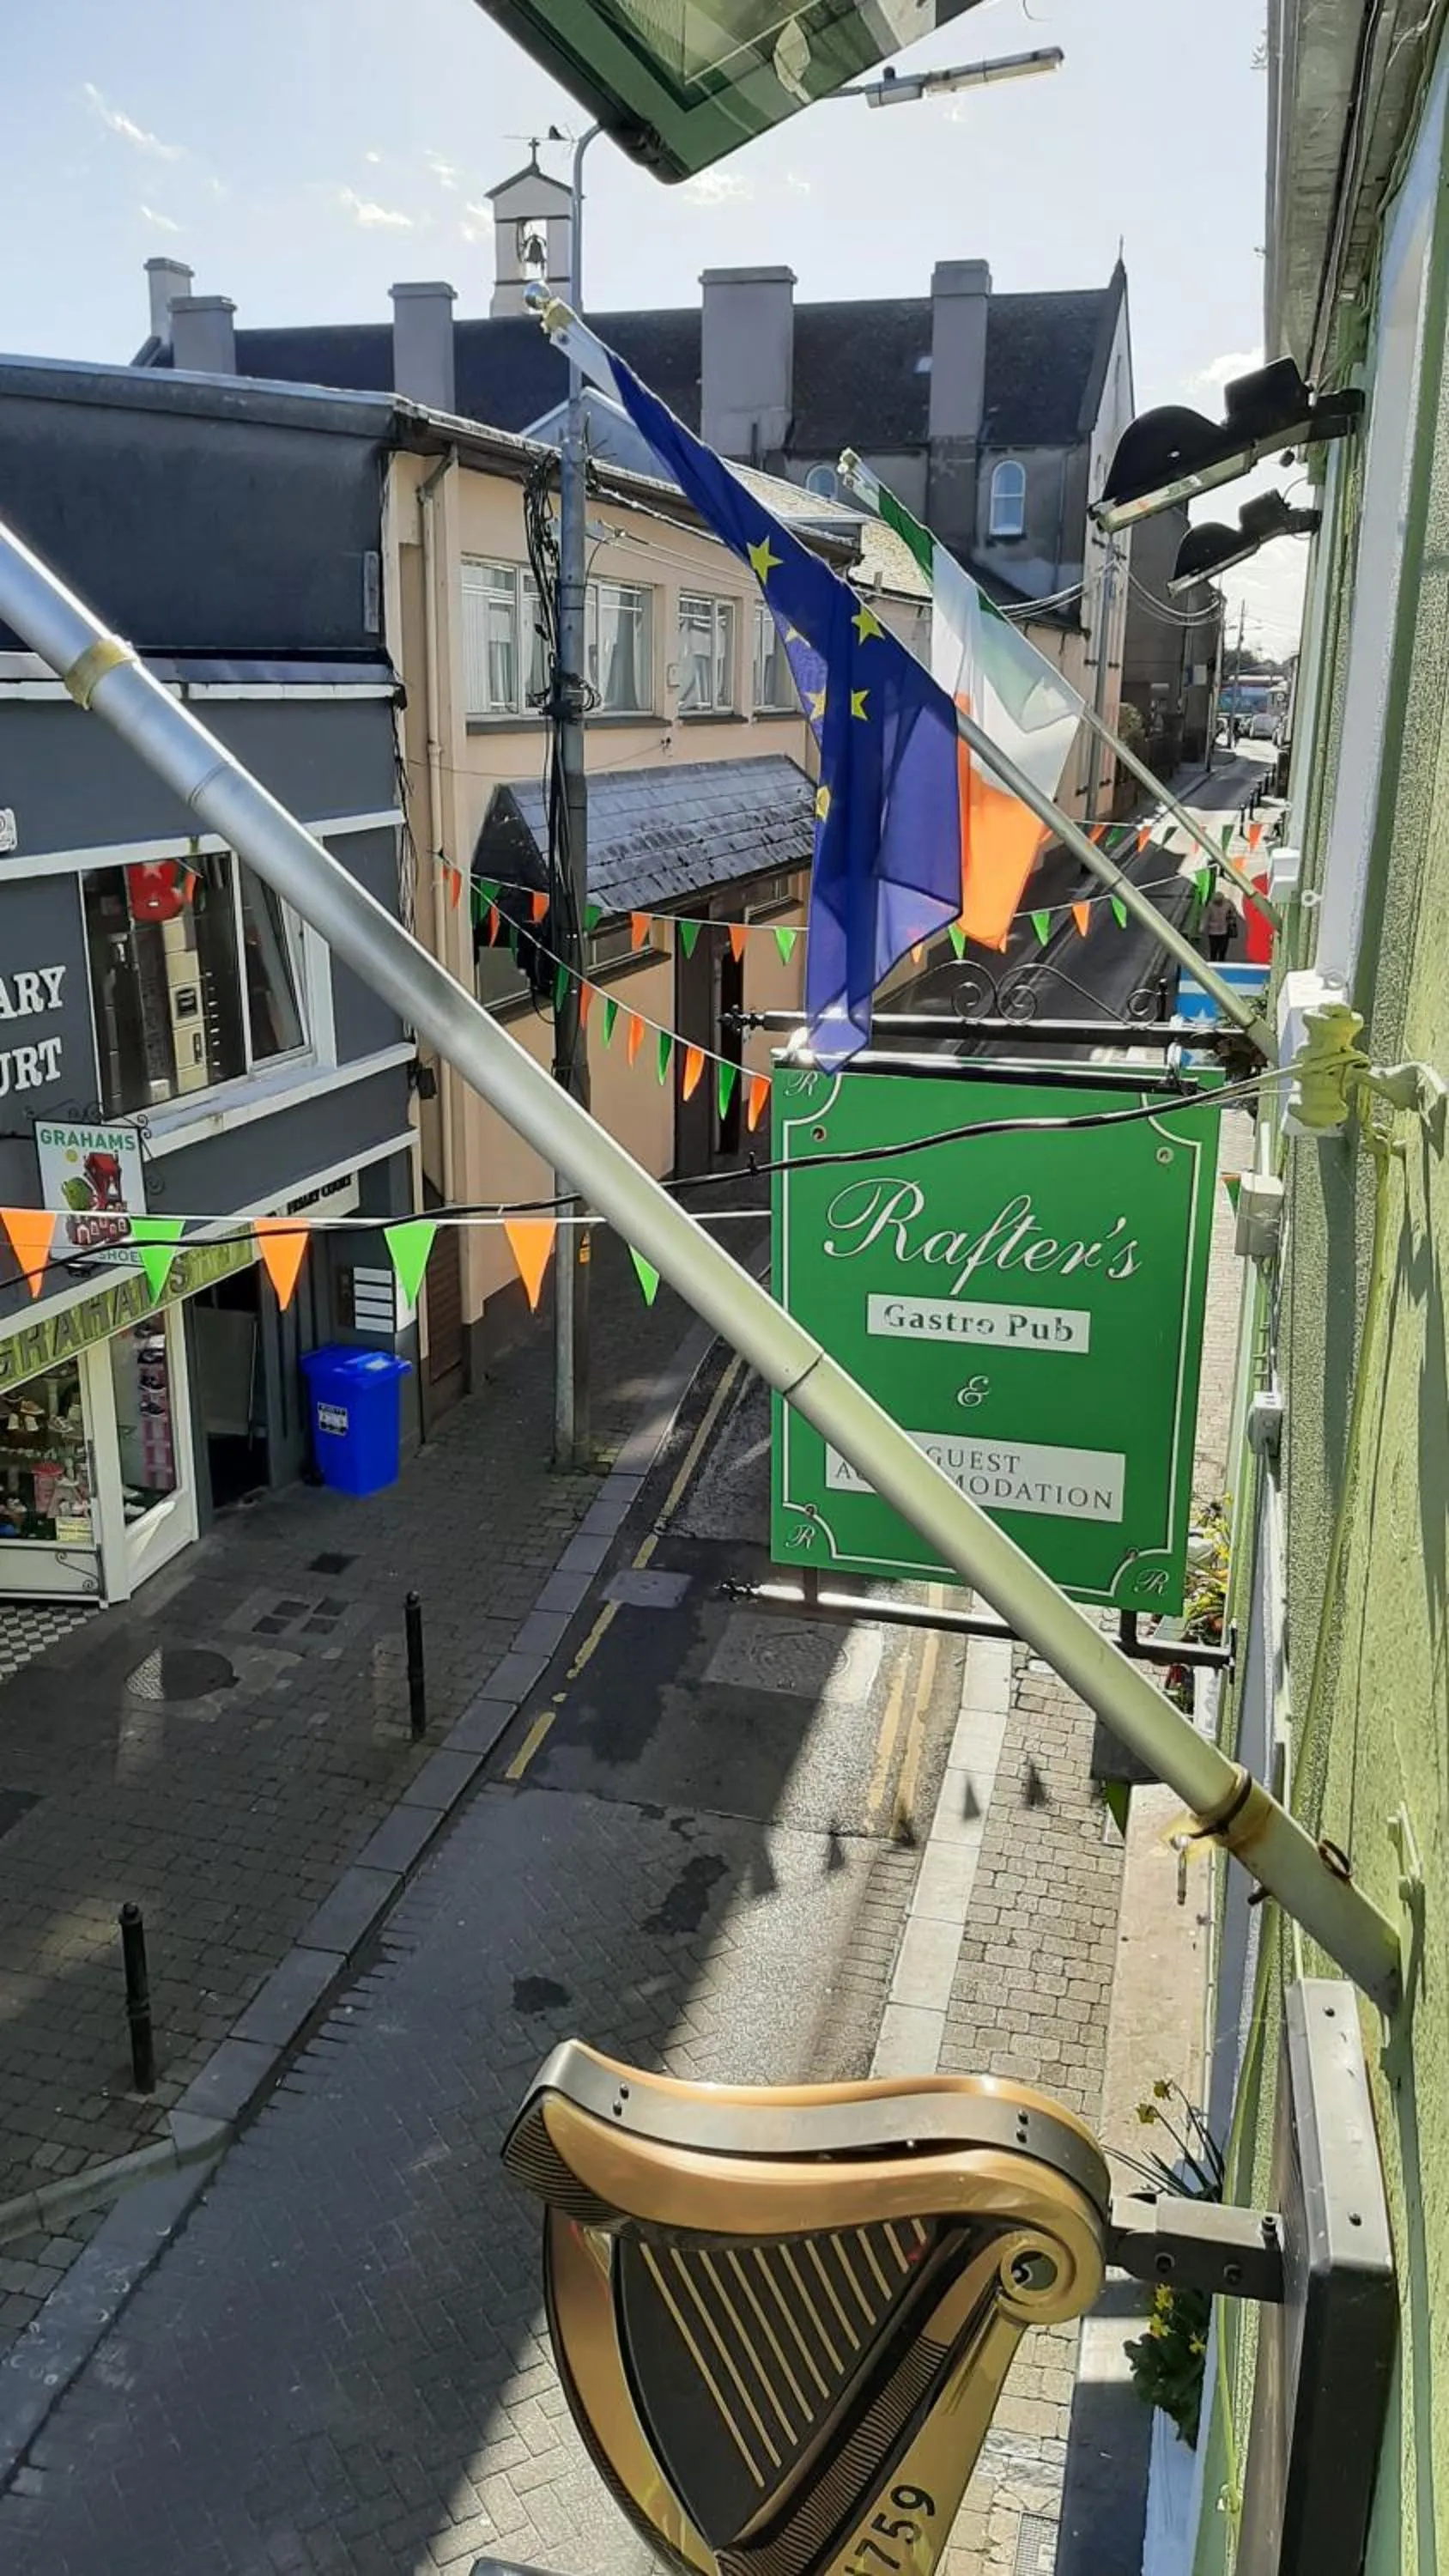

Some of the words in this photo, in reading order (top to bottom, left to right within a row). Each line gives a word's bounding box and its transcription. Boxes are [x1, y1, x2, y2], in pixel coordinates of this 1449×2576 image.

[40, 1129, 136, 1151] GRAHAMS
[823, 1177, 1143, 1297] Rafter's
[98, 1249, 143, 1263] SHOE
[883, 1303, 994, 1334] Gastro
[1005, 1313, 1074, 1343] Pub
[957, 1375, 990, 1407] &
[926, 1446, 1021, 1474] GUEST
